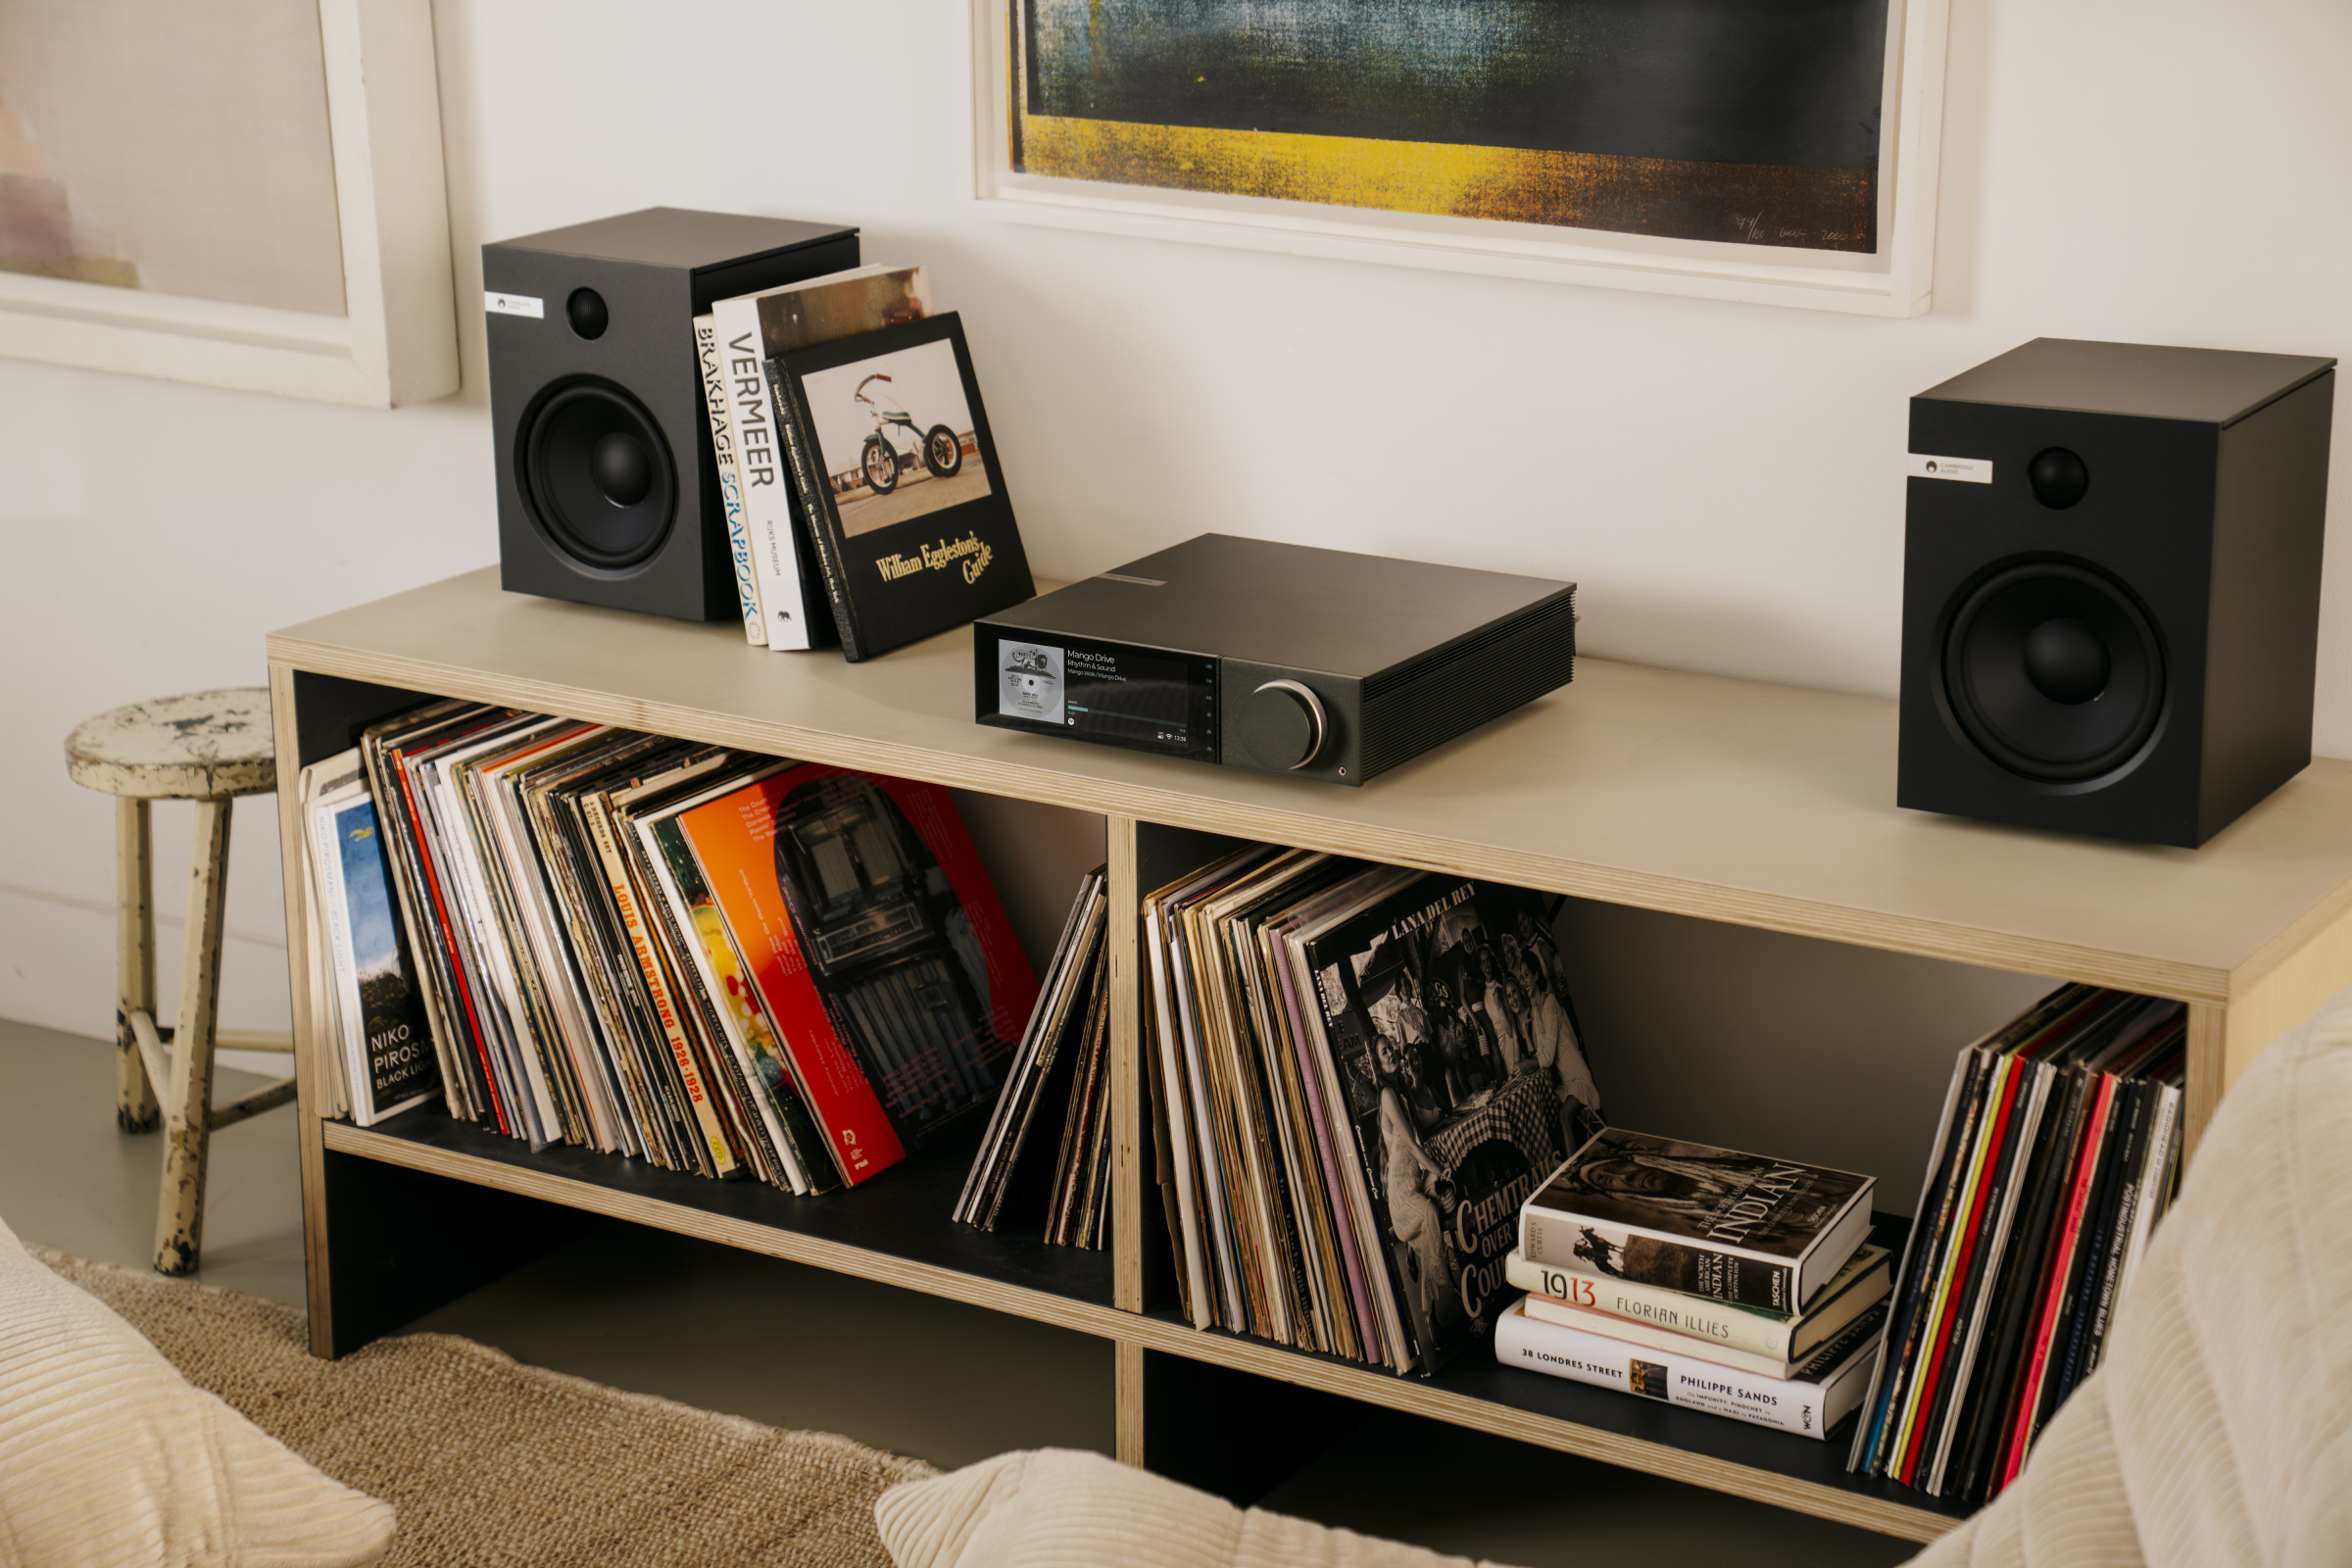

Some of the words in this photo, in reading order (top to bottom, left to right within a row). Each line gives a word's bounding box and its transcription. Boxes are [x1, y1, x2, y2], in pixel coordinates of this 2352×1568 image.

[726, 331, 775, 488] VERMEER
[697, 326, 733, 466] BRAKHAGE
[720, 469, 759, 619] SCRAPBOOK
[767, 542, 781, 576] MUSEUM
[875, 551, 922, 582] William
[923, 530, 981, 571] Eggleston's
[961, 541, 994, 584] Guide
[1067, 650, 1095, 662] Mango
[1095, 654, 1115, 664] Drive
[1067, 660, 1091, 668] Rhythm
[1096, 663, 1116, 672] Sound
[738, 804, 751, 813] The
[742, 810, 754, 821] The
[590, 806, 606, 838] RECORDS
[602, 839, 612, 855] SET
[752, 832, 765, 843] The
[1391, 914, 1427, 941] LANA
[1425, 899, 1451, 919] DEL
[1450, 881, 1477, 906] REY
[612, 883, 639, 940] LOUIS
[631, 934, 676, 1029] ARMSTRONG
[825, 992, 845, 1021] Lovers
[1313, 968, 1324, 992] LANA
[1319, 992, 1329, 1009] DEL
[1324, 1009, 1333, 1028] REY
[370, 1023, 410, 1053] NIKO
[806, 1028, 827, 1064] Hallyday
[839, 1023, 859, 1056] Modern
[375, 1067, 410, 1090] BLACK
[821, 1065, 841, 1098] Johnny
[2157, 1102, 2175, 1156] RADIOHEAD
[1697, 1214, 1718, 1229] THE
[1714, 1195, 1735, 1214] NORTH
[1706, 1162, 1807, 1245] INDIAN
[2113, 1184, 2137, 1256] POSTINDUSTRIAL
[1481, 1225, 1513, 1258] OVER
[1541, 1270, 1596, 1306] 1913
[1711, 1252, 1724, 1299] INDIAN
[1772, 1270, 1781, 1307] TASCHEN
[2100, 1256, 2120, 1307] HOMETOWN
[1616, 1297, 1678, 1324] FLORIAN
[1685, 1314, 1730, 1339] ILLIES
[2092, 1306, 2107, 1337] BLUES
[1521, 1348, 1534, 1358] 38
[1537, 1350, 1583, 1370] LONDRES
[1587, 1360, 1624, 1379] STREET
[1681, 1375, 1733, 1396] PHILIPPE
[1738, 1389, 1778, 1406] SANDS
[1696, 1394, 1729, 1406] IMPUNITY,
[1731, 1401, 1762, 1413] PINOCHET
[1676, 1396, 1705, 1407] ENGLAND
[1748, 1413, 1784, 1426] PATAGONIA
